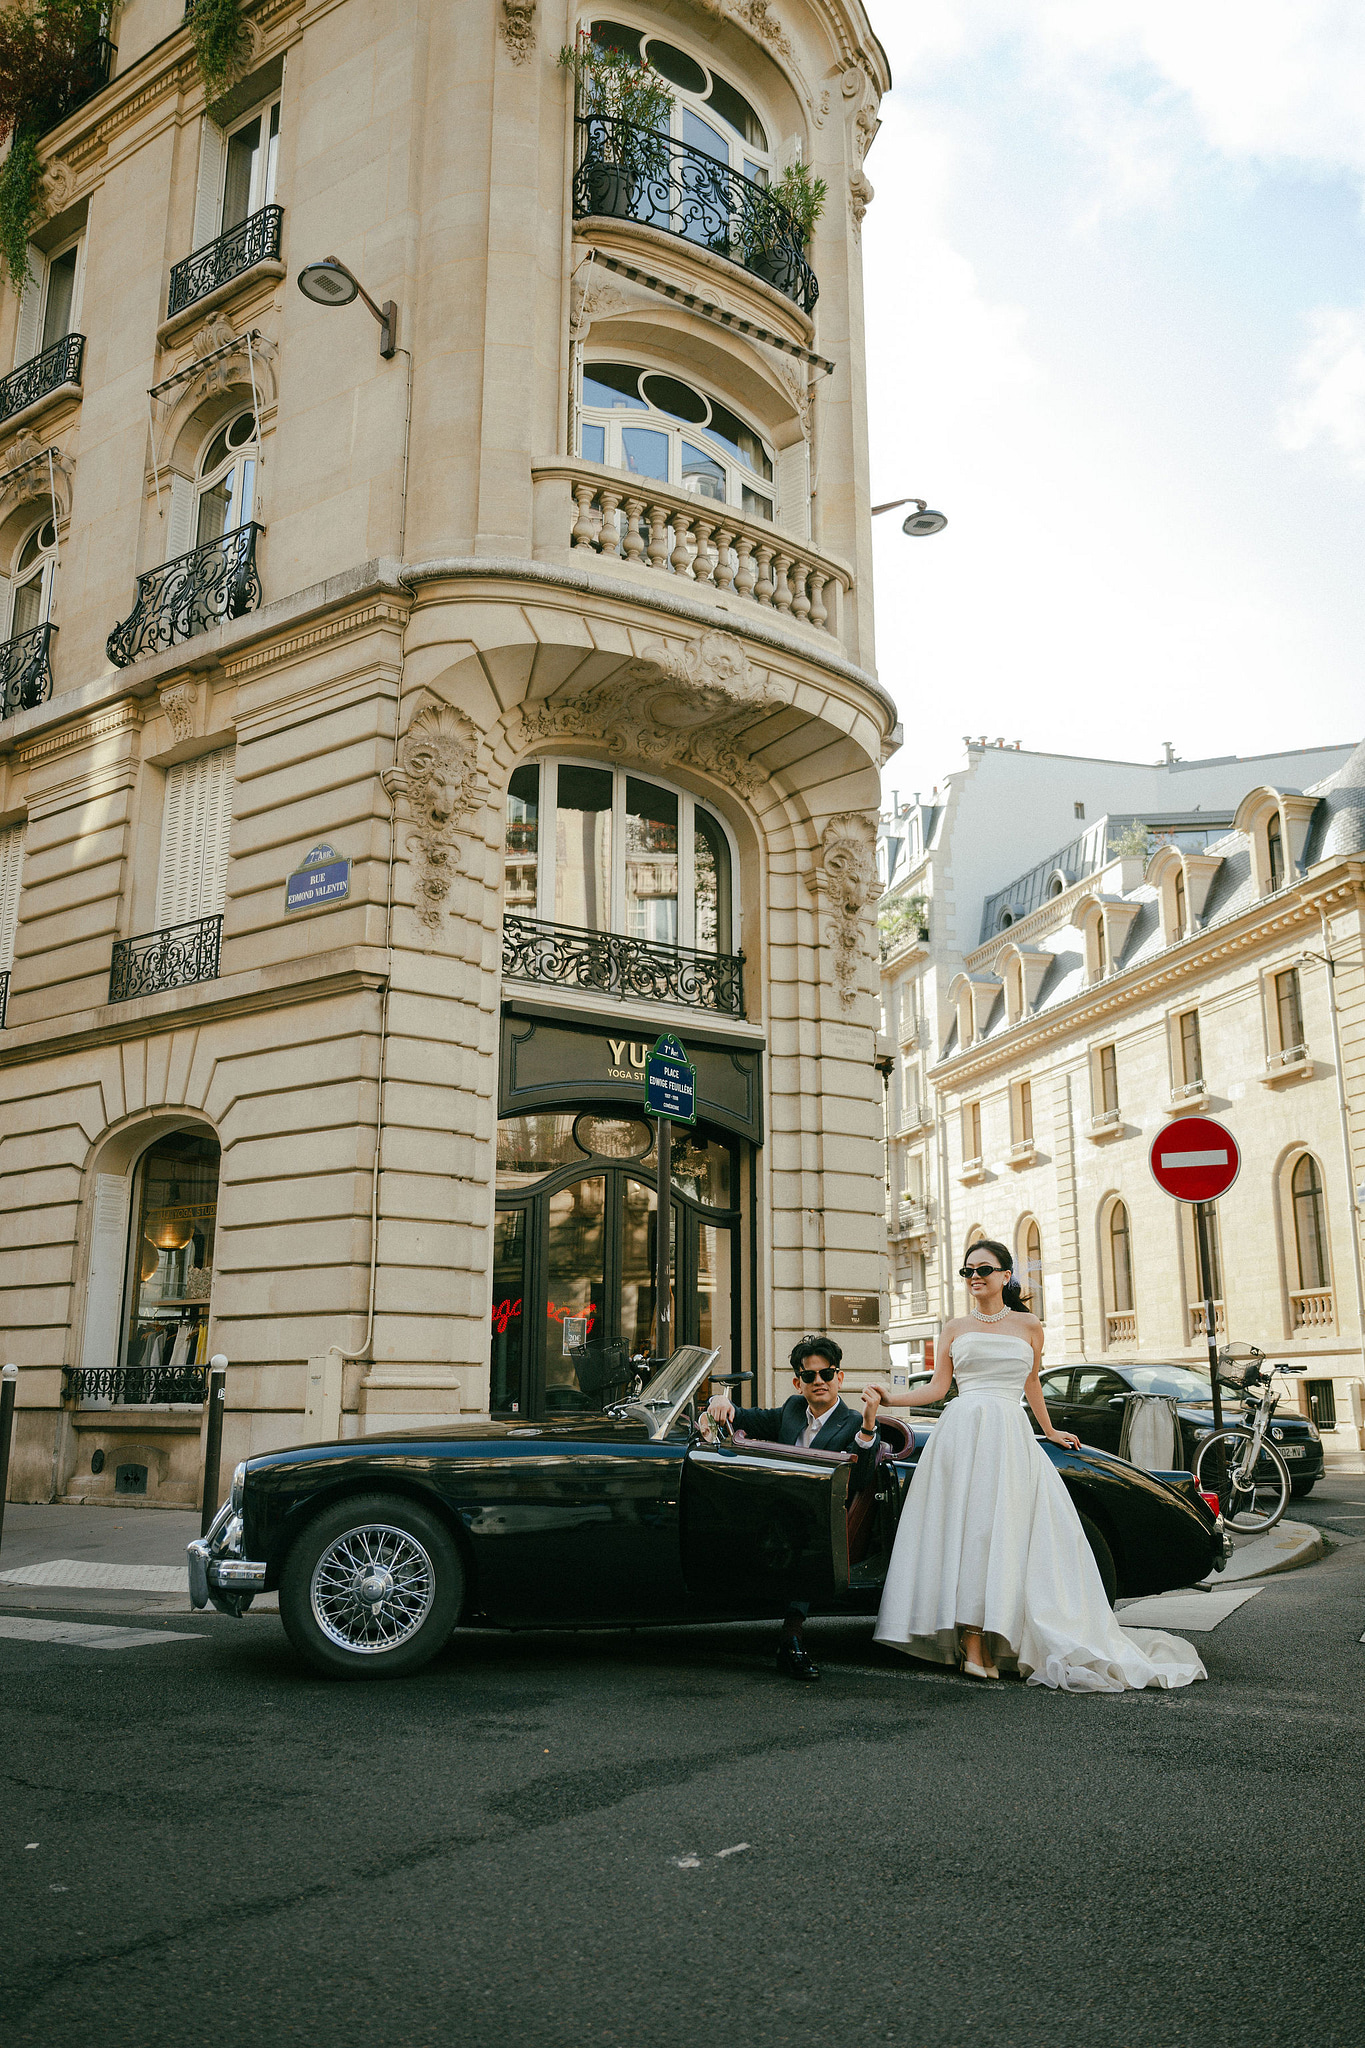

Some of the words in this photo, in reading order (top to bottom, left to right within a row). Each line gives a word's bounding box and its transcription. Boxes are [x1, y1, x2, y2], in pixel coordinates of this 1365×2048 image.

[310, 873, 325, 885] RUE
[288, 890, 314, 904] EDMOND
[315, 881, 347, 896] VALENTIN
[607, 1068, 632, 1079] YOGA
[664, 1066, 679, 1079] PLACE
[649, 1075, 668, 1089] EDWIGE
[668, 1081, 693, 1096] FEUILLÈRE
